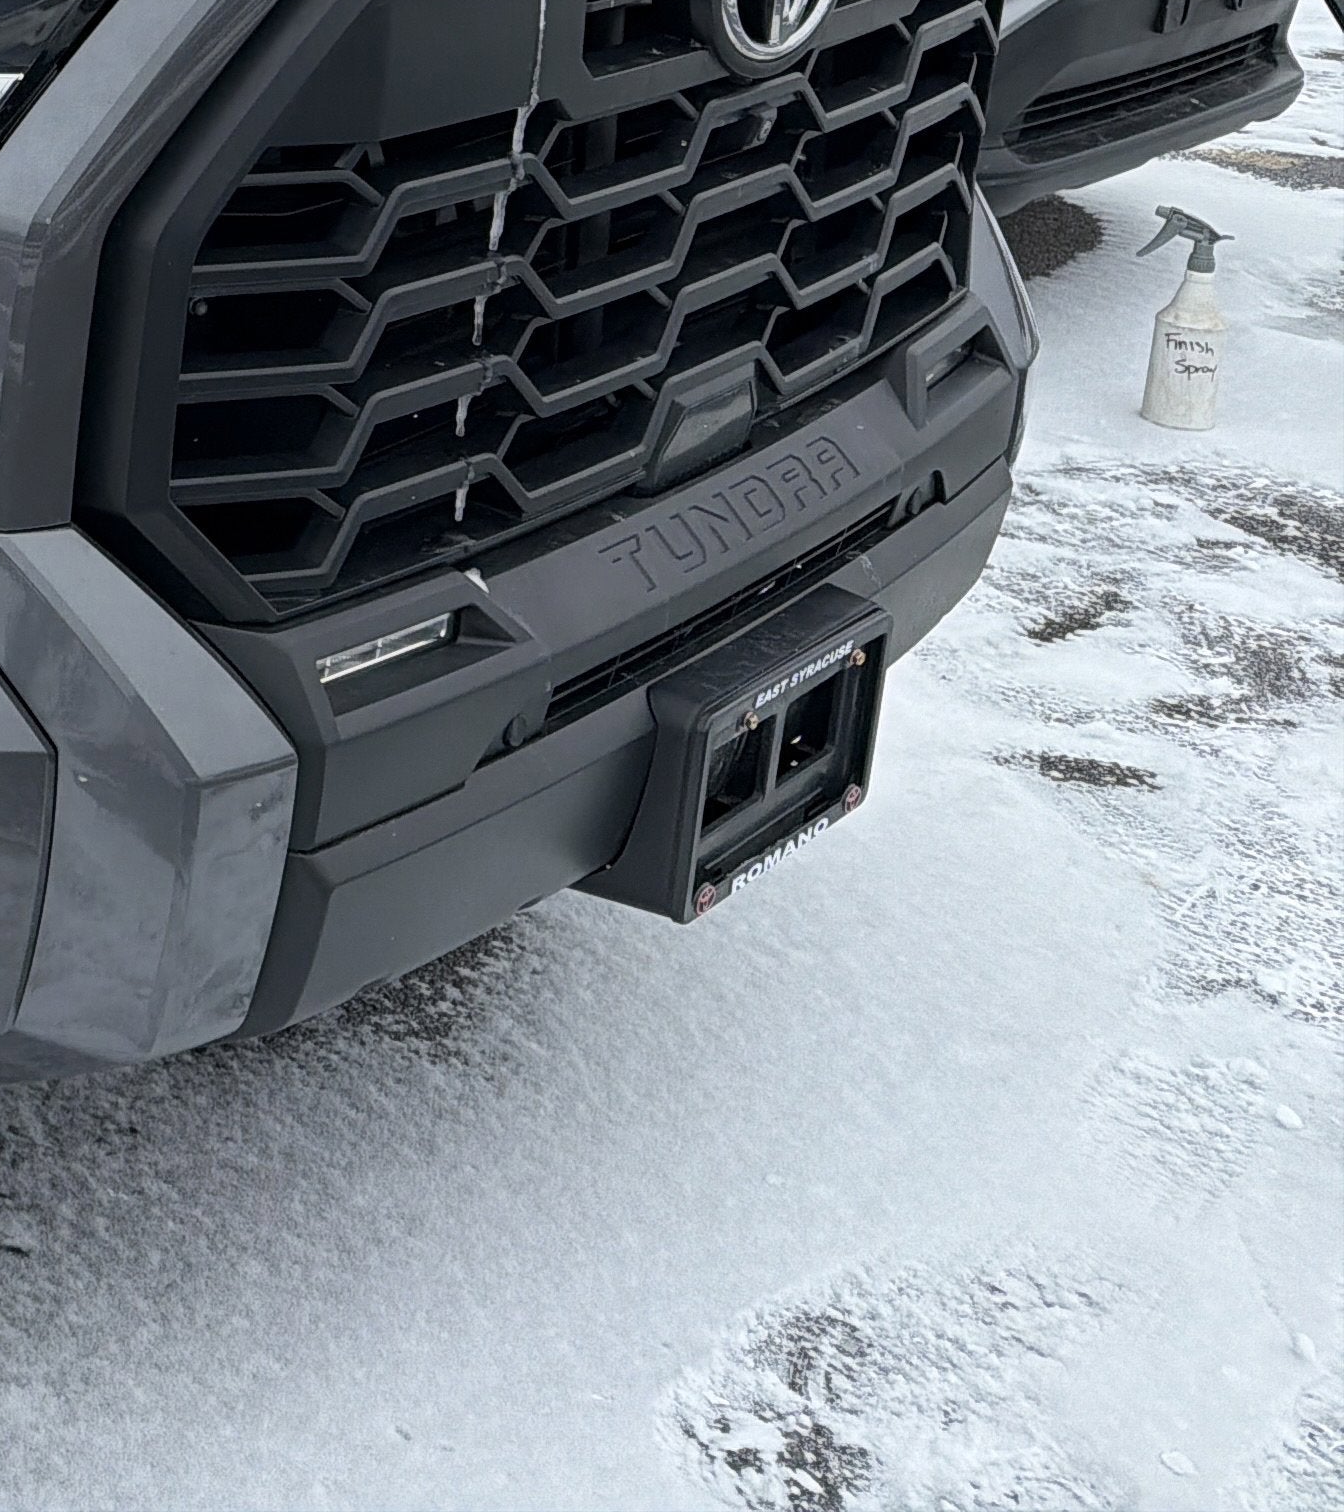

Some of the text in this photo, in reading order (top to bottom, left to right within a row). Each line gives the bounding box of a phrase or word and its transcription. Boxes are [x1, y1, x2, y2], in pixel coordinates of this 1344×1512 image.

[1164, 332, 1215, 357] Finish
[1174, 359, 1218, 383] Spray
[597, 435, 861, 593] TUNDRA
[755, 639, 855, 710] EAST SYRACUSE
[731, 817, 830, 896] ROMANO
